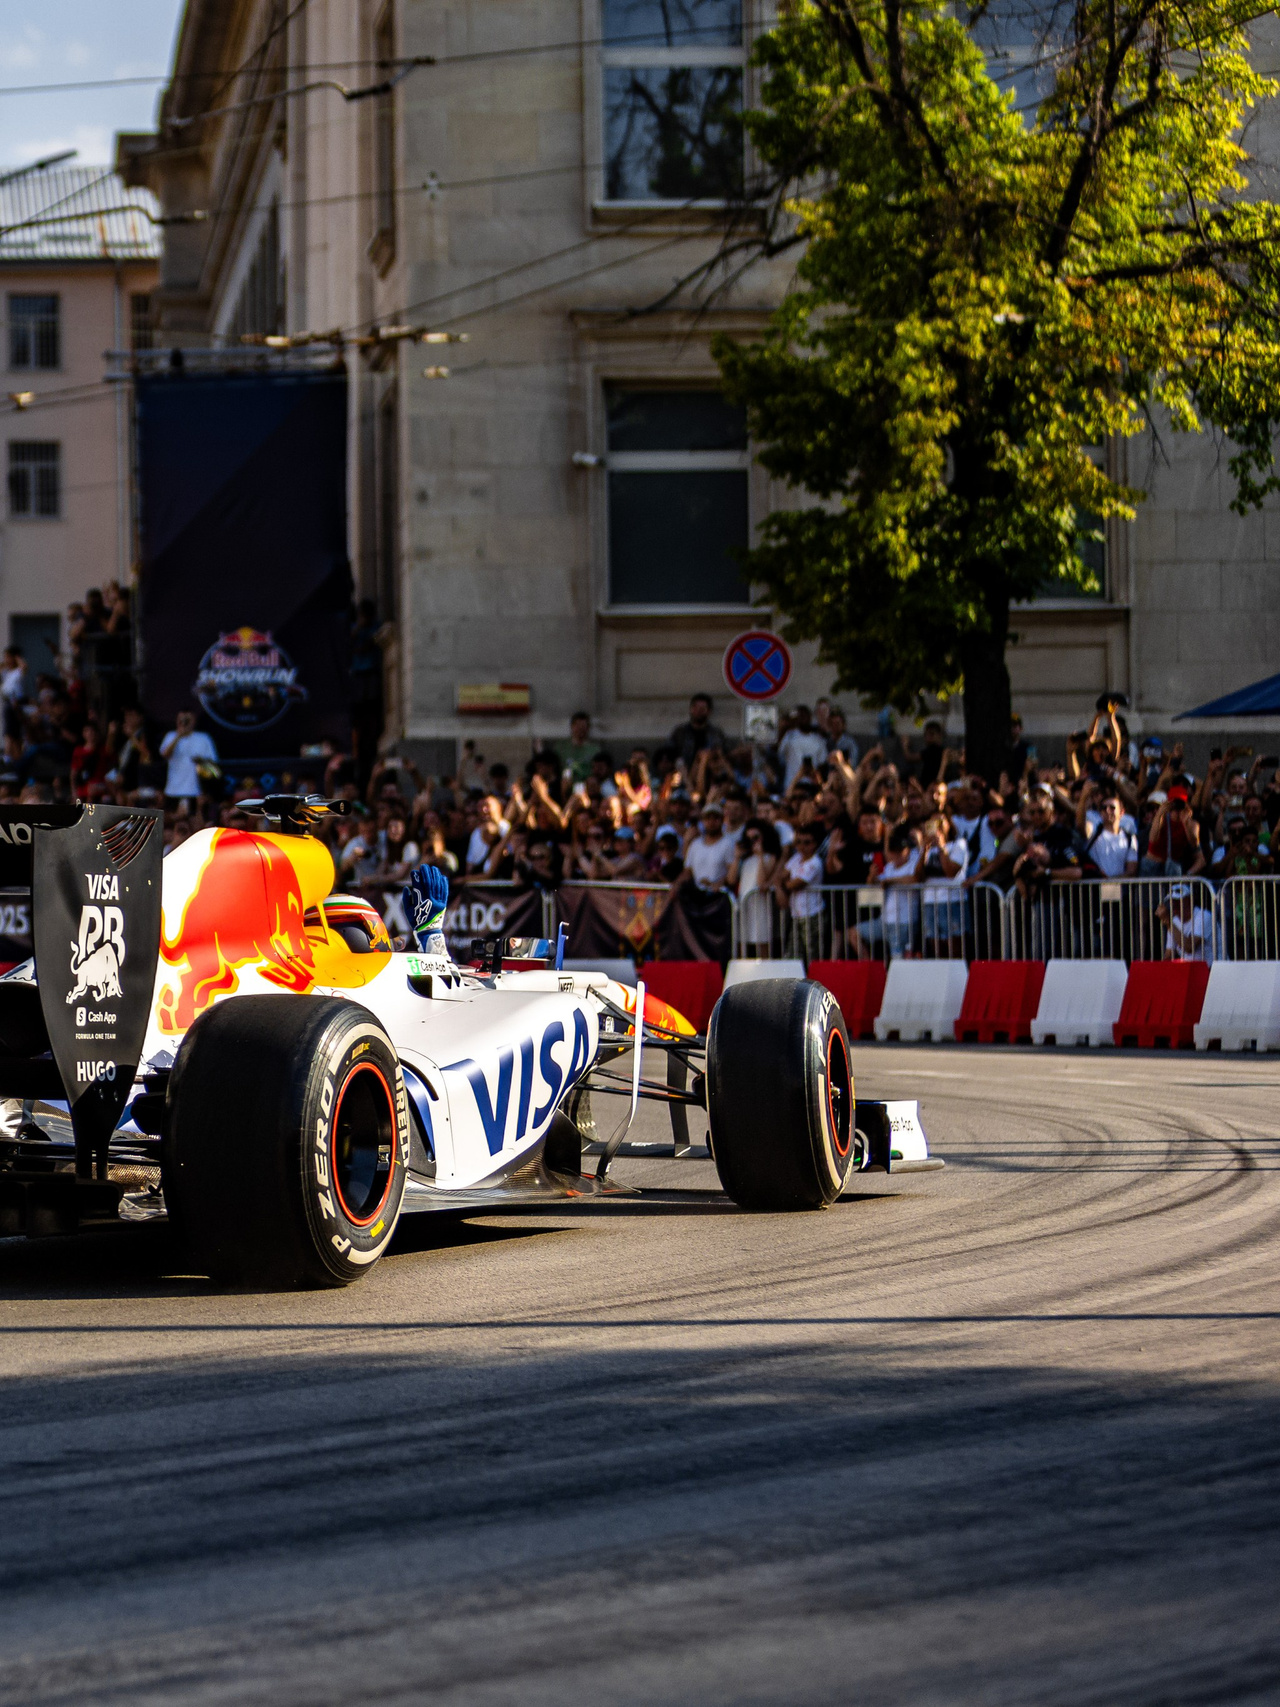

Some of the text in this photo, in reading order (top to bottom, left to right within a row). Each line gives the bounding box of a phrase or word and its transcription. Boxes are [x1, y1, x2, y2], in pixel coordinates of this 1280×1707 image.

[85, 874, 119, 900] VISA
[471, 903, 507, 931] DC
[88, 1011, 103, 1022] Cash
[103, 1012, 117, 1023] App
[76, 1060, 116, 1082] HUGO
[439, 1007, 590, 1157] VISA
[314, 1075, 351, 1254] P ZERO
